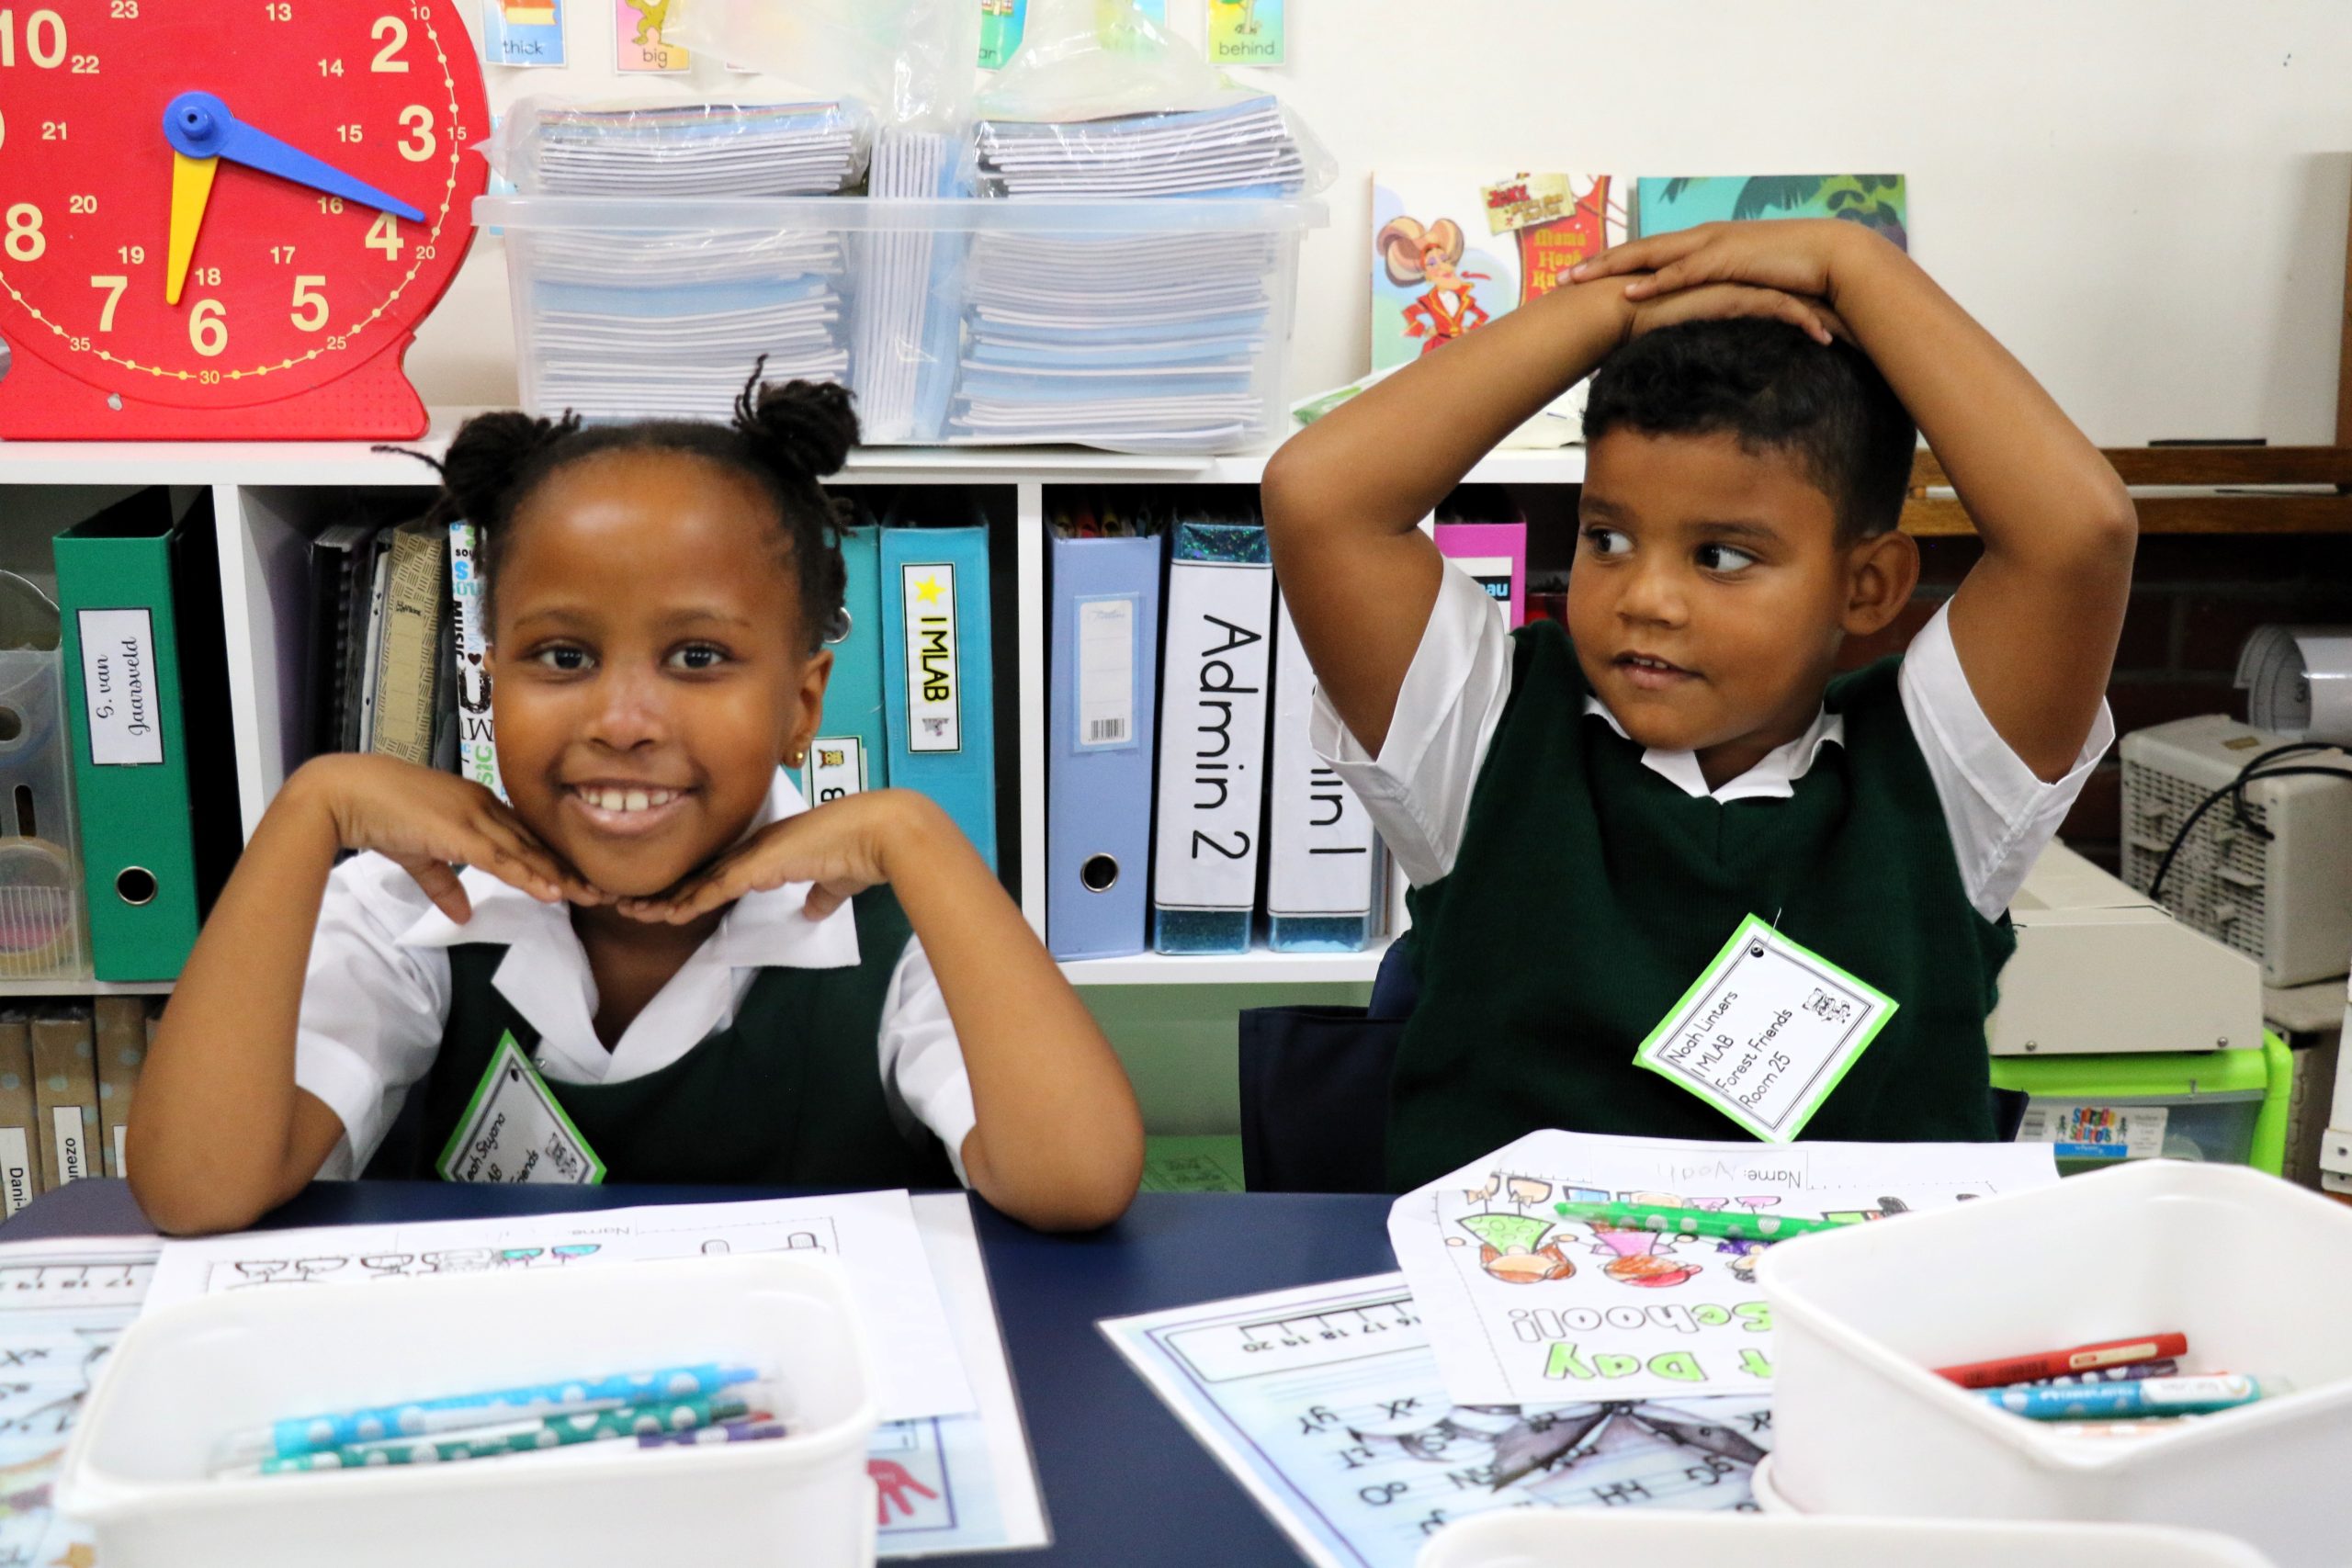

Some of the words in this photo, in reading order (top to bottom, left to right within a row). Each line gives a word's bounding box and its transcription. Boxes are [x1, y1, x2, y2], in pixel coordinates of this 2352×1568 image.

[111, 1, 139, 18] 23
[266, 4, 292, 21] 13
[411, 7, 430, 20] 10
[0, 10, 67, 67] 10
[370, 16, 410, 73] 2
[503, 39, 543, 55] thick
[642, 48, 667, 67] big
[1219, 41, 1275, 56] behind
[72, 56, 99, 73] 22
[319, 60, 344, 76] 14
[42, 122, 67, 140] 21
[336, 125, 363, 141] 15
[398, 105, 436, 162] 3
[447, 127, 467, 140] 15
[70, 196, 97, 213] 20
[317, 197, 343, 214] 16
[5, 203, 46, 262] 8
[365, 212, 403, 261] 4
[119, 246, 144, 264] 19
[270, 246, 296, 264] 17
[415, 246, 435, 260] 20
[195, 268, 221, 286] 18
[91, 276, 128, 332] 7
[290, 276, 329, 332] 5
[188, 299, 228, 356] 6
[70, 338, 90, 351] 35
[326, 336, 346, 349] 25
[200, 371, 220, 384] 30
[1484, 583, 1508, 596] au
[97, 654, 111, 694] van
[121, 637, 151, 736] Jaarsveld
[1195, 614, 1261, 809] Admin
[1192, 830, 1250, 859] 2
[1667, 1030, 1703, 1064] Noah
[1700, 990, 1738, 1033] Linters
[1696, 1033, 1735, 1072] MLAB
[1714, 1051, 1758, 1093] Forest
[1747, 1008, 1793, 1053] Friends
[1738, 1071, 1779, 1110] Room
[1768, 1051, 1792, 1075] 25
[1744, 1168, 1801, 1189] Name:
[1363, 1323, 1388, 1334] 17
[1508, 1301, 1771, 1342] School!
[1281, 1336, 1311, 1348] 19
[1320, 1328, 1350, 1340] 18
[1242, 1341, 1274, 1353] 20
[1544, 1342, 1709, 1381] Day
